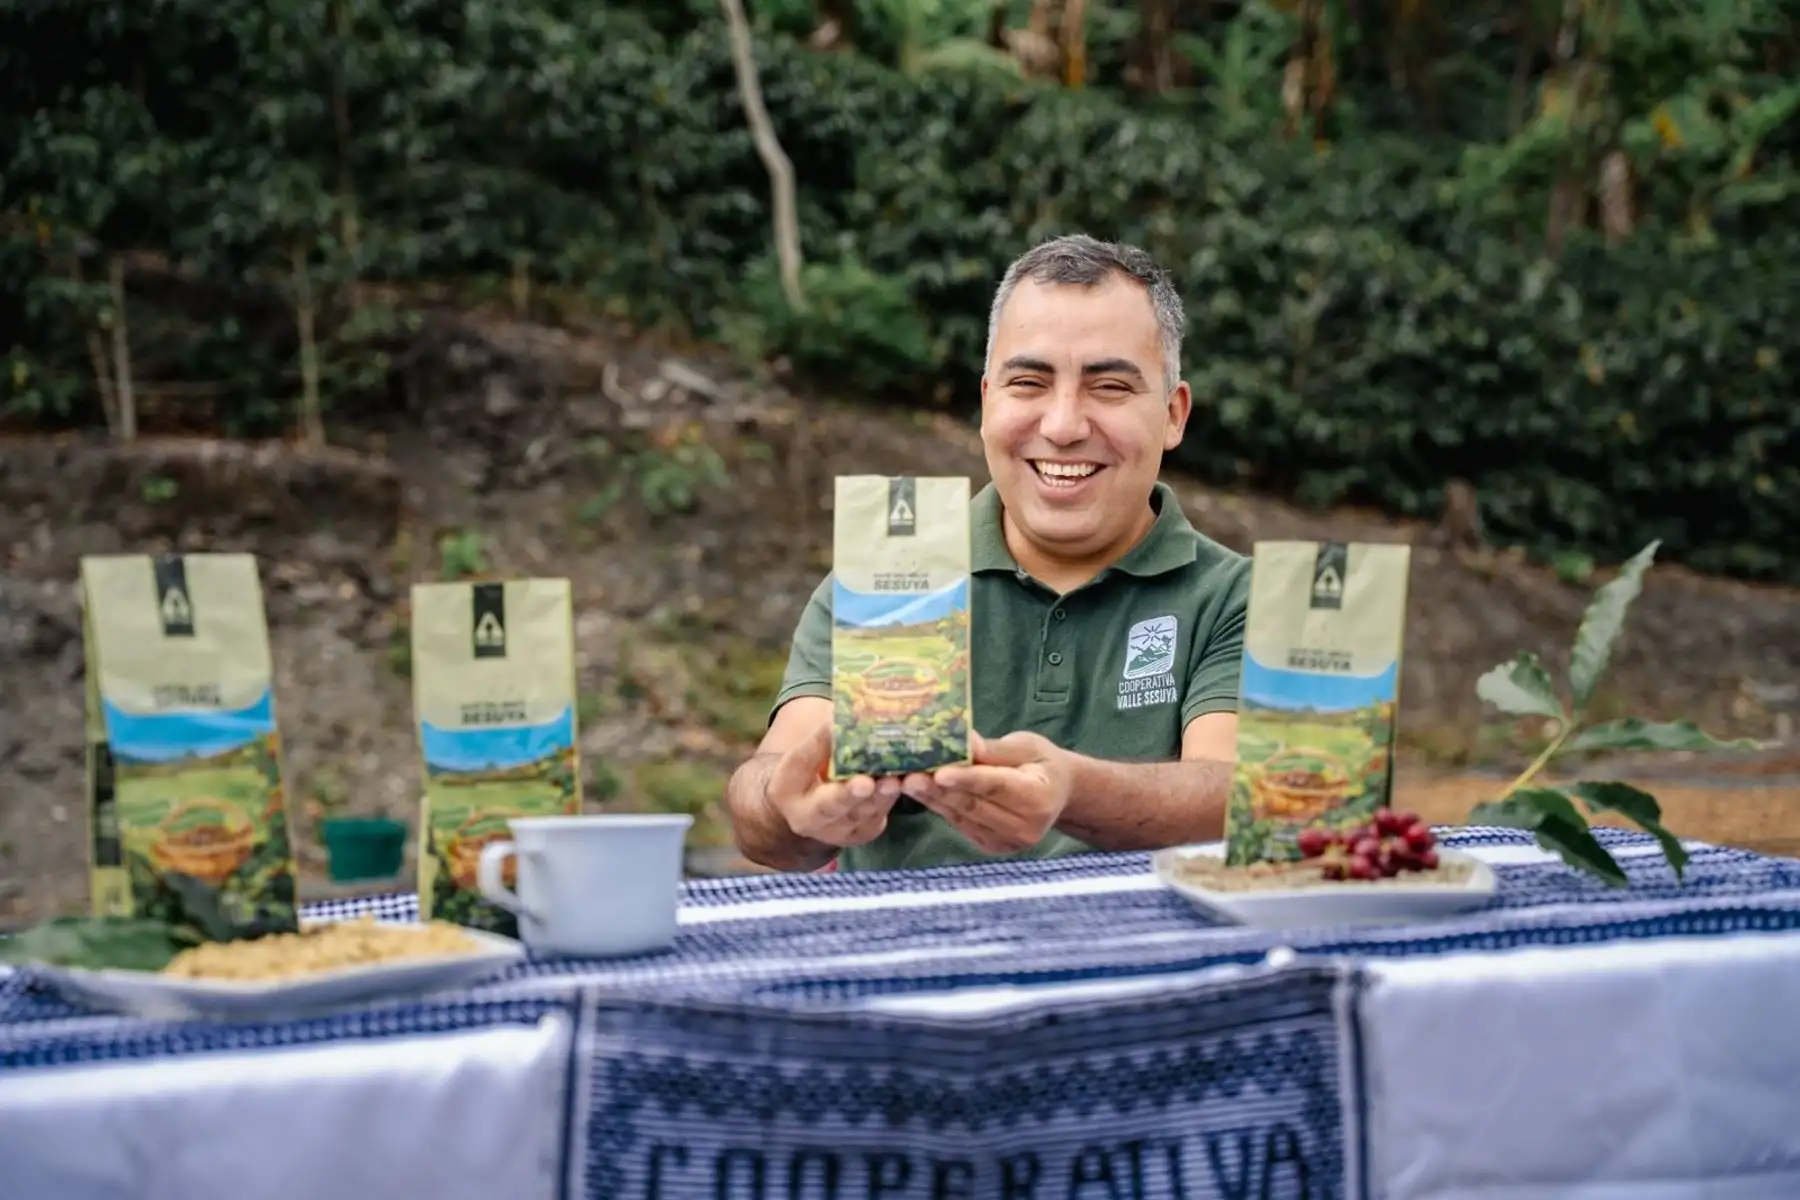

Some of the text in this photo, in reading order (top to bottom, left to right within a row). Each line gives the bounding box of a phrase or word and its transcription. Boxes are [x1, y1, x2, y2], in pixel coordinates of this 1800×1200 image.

[873, 579, 929, 591] SESUYA
[1118, 673, 1176, 694] COOPERATIVA
[1117, 687, 1178, 709] VALLE SESUYA
